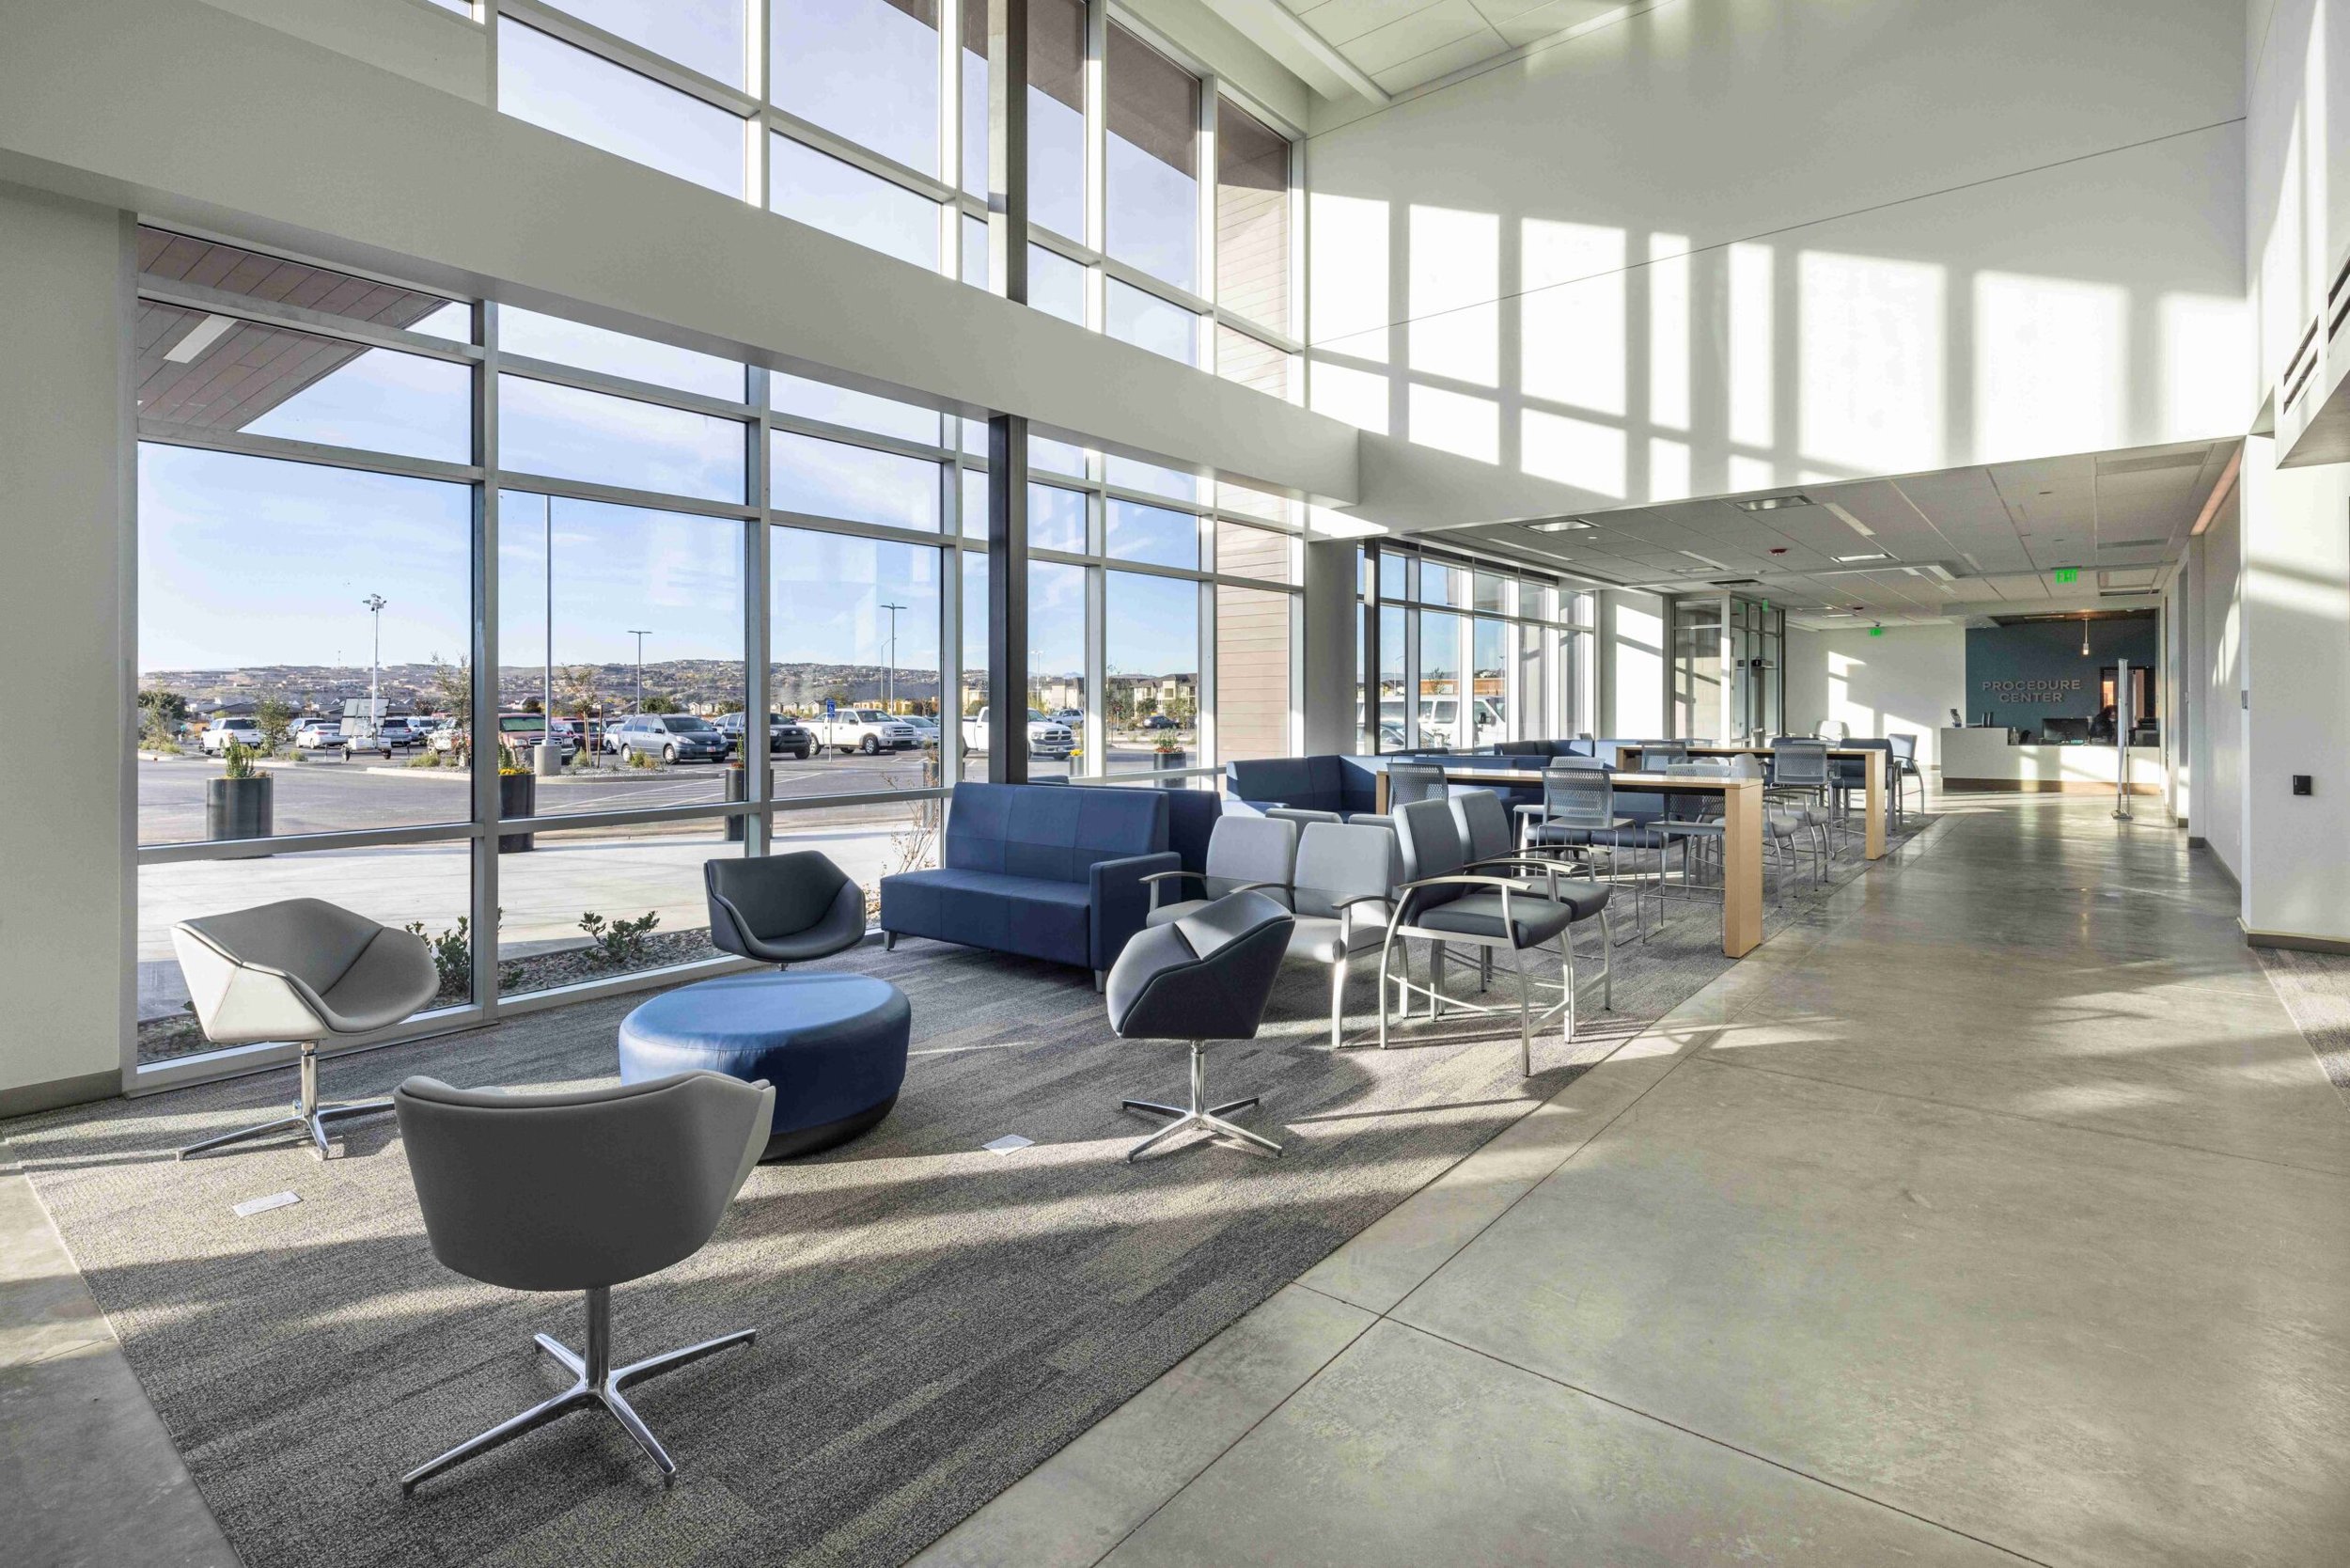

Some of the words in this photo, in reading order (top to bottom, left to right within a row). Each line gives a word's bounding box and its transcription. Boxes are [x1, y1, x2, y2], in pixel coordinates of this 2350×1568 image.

[2056, 569, 2077, 583] EXIT
[1982, 680, 2081, 691] PROCEDURE
[1999, 692, 2062, 703] CENTER
